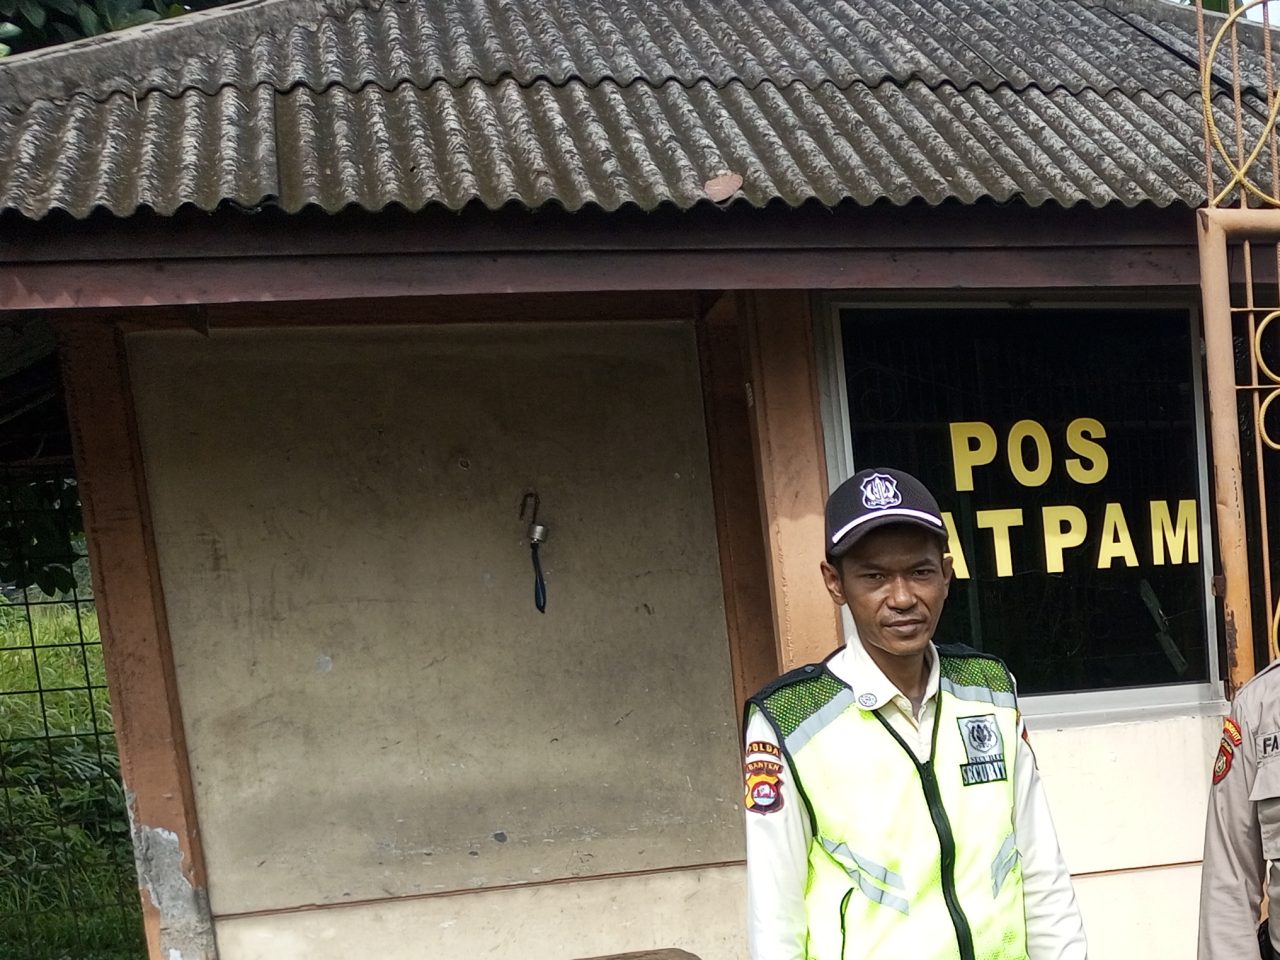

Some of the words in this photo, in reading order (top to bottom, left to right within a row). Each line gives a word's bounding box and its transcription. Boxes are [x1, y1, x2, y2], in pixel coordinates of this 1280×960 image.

[949, 417, 1109, 492] POS
[942, 499, 1200, 579] ATPAM
[748, 762, 780, 771] BANTEN
